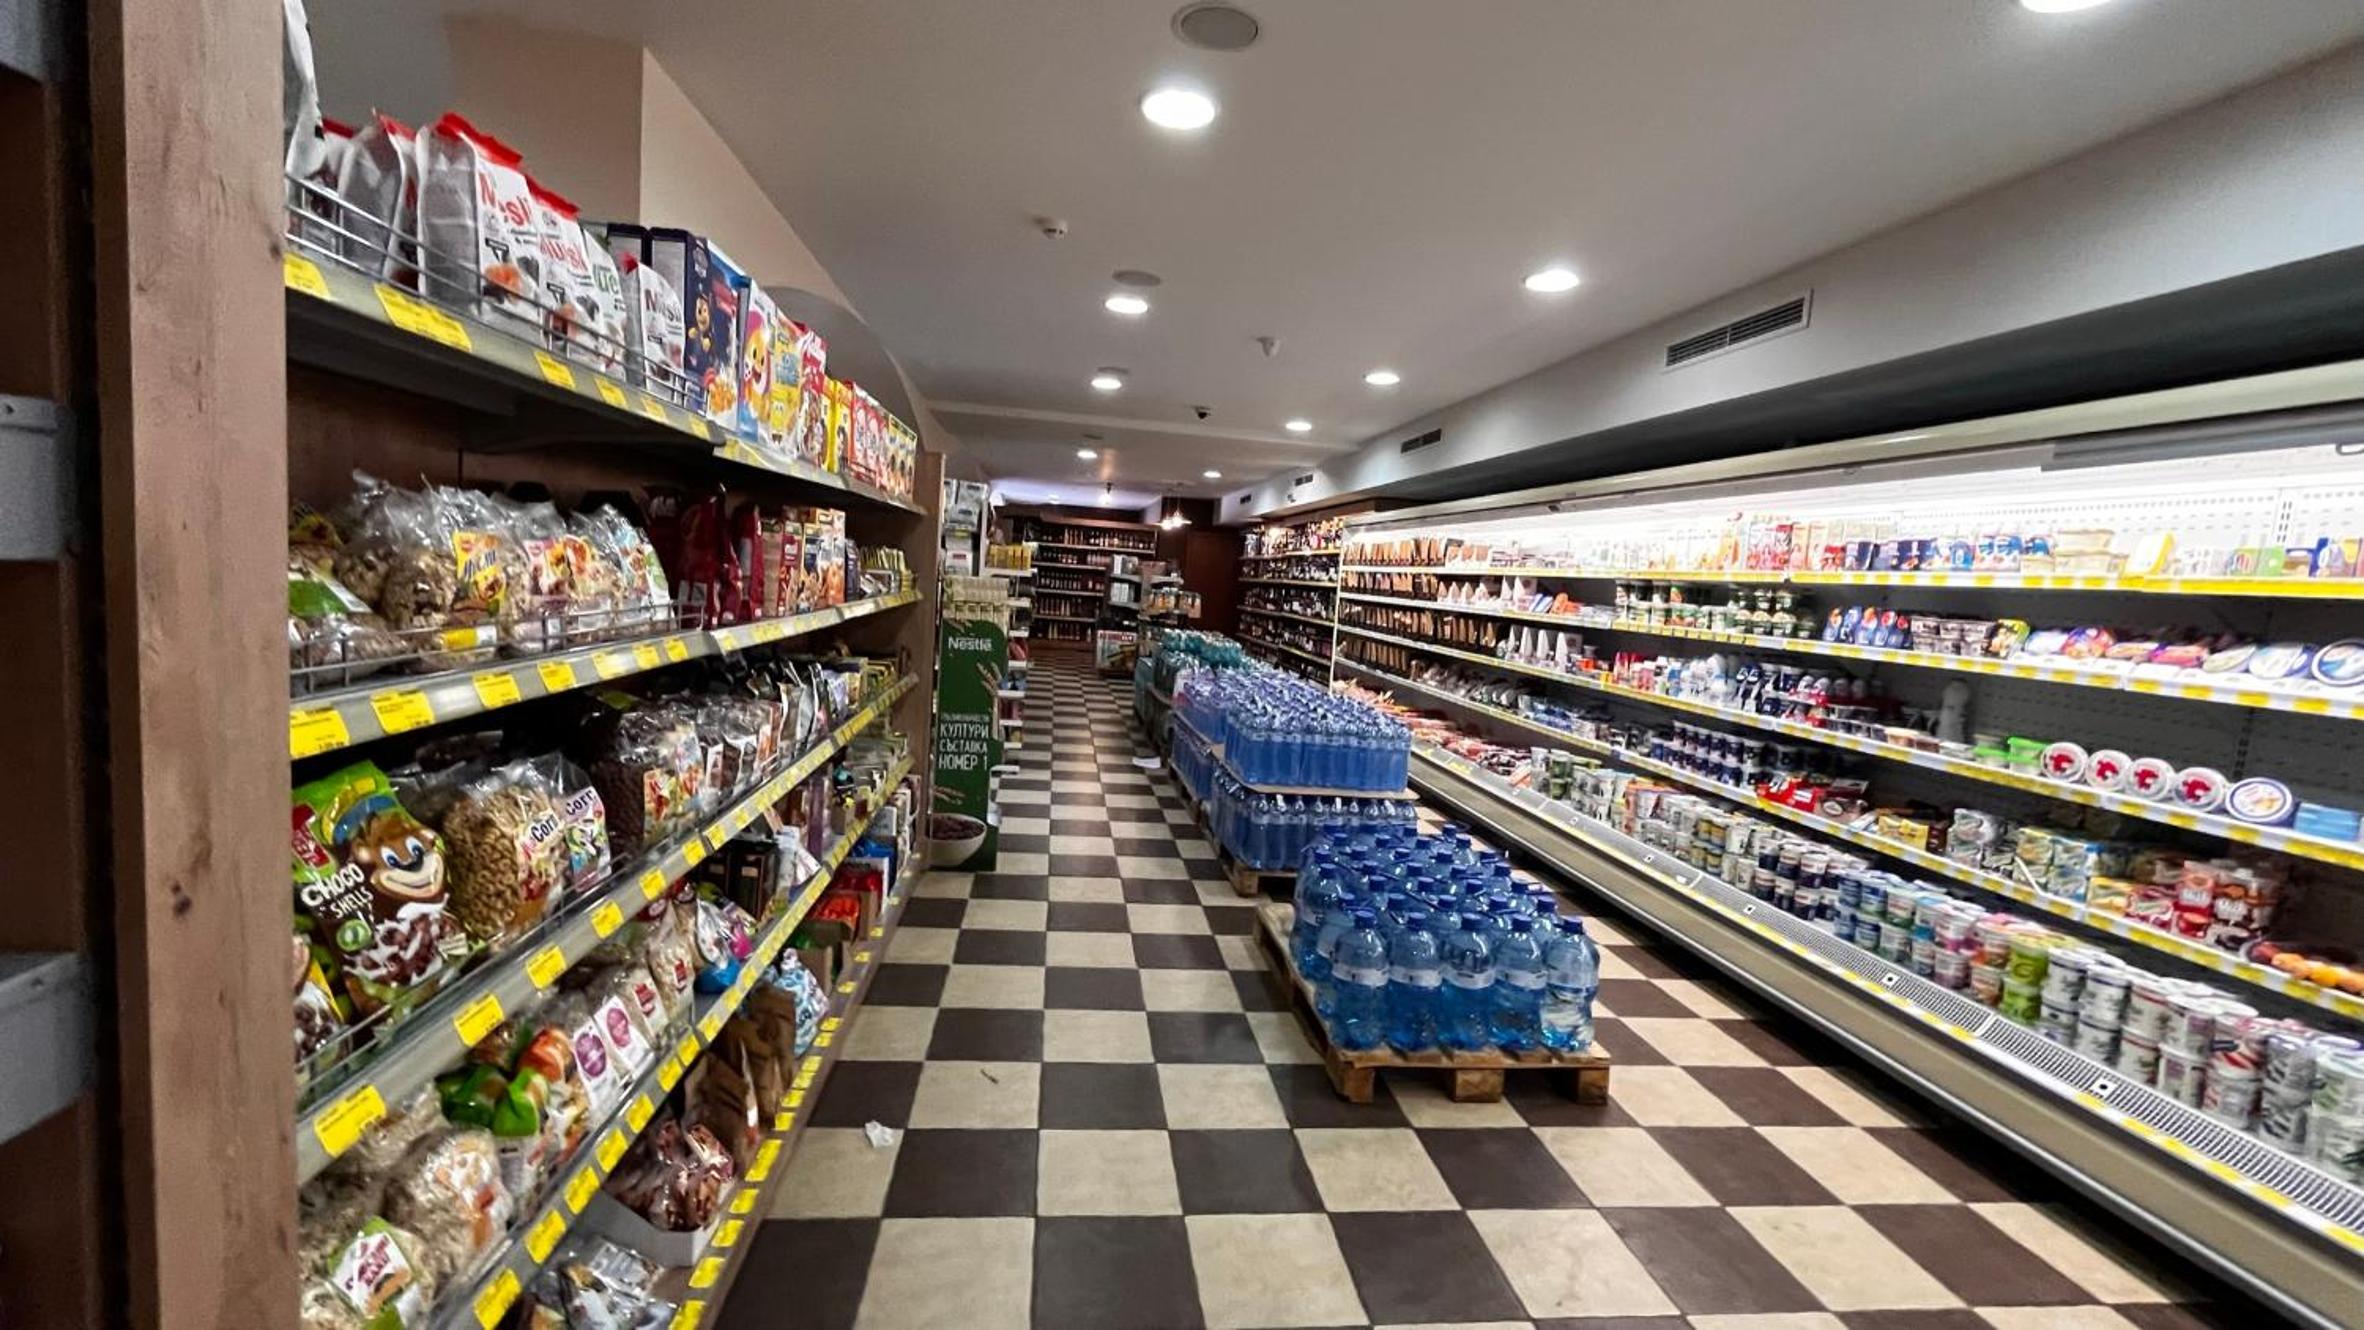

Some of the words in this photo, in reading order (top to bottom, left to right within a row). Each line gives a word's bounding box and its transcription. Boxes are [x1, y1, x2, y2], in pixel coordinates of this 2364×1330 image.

[940, 723, 989, 739] КУЛТУРИ
[939, 738, 988, 754] СЪСТАВКА
[938, 753, 978, 770] НОМЕР
[301, 863, 365, 907] CHOCO
[330, 886, 375, 919] SHELLS
